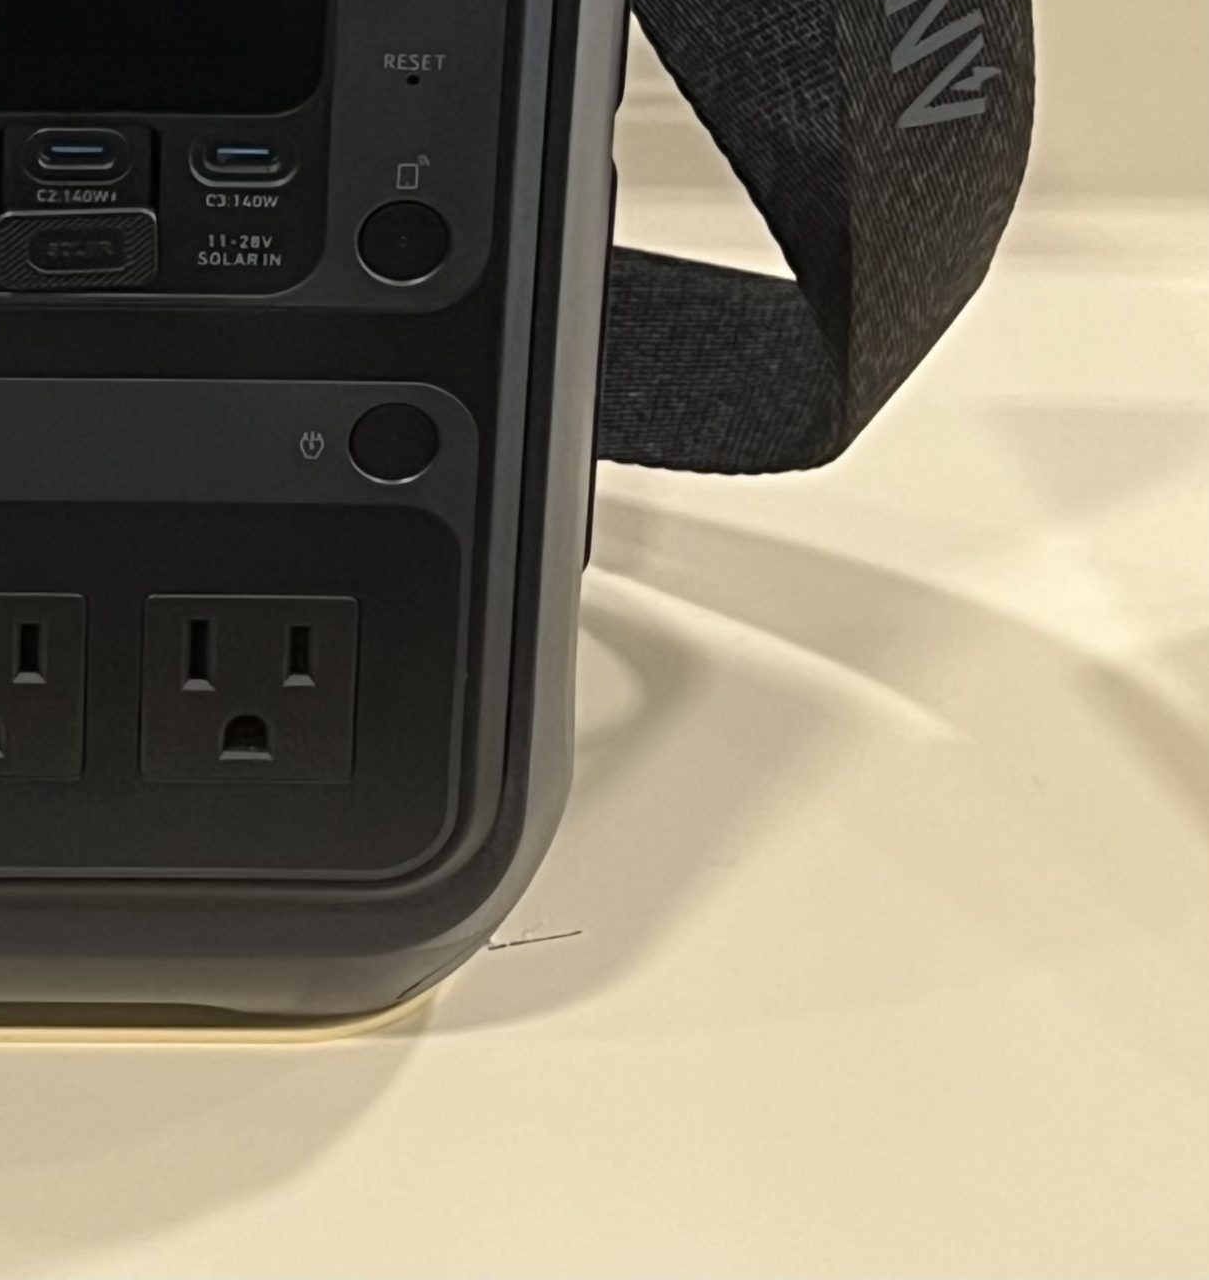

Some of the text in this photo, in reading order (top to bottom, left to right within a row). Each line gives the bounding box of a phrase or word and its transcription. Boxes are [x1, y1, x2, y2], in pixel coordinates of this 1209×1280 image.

[384, 53, 446, 70] RESET
[207, 235, 273, 249] 11-28V
[197, 252, 282, 267] SOLAR IN
